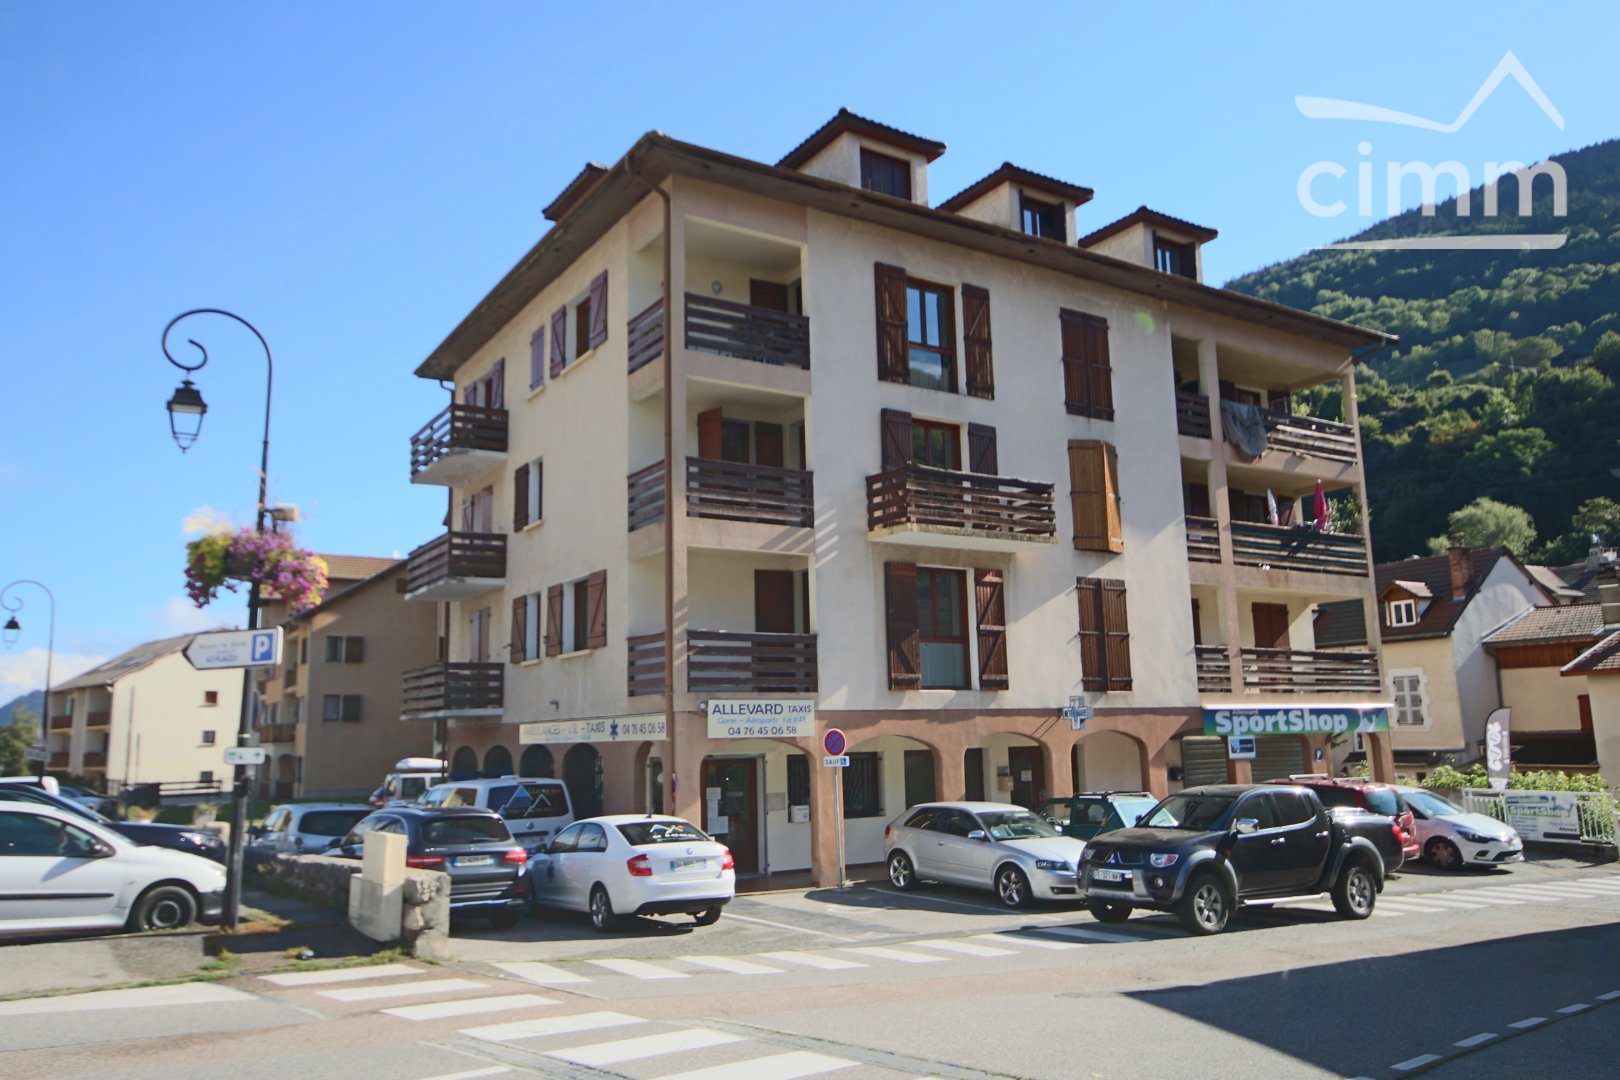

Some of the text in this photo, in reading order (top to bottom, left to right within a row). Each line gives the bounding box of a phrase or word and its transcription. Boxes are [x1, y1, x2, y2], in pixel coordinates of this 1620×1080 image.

[254, 636, 270, 660] P
[712, 703, 811, 715] ALLEVARD TAXIS
[586, 721, 606, 734] TAXIS
[622, 723, 631, 735] 04
[631, 723, 638, 735] 76
[639, 722, 647, 735] 45
[648, 722, 657, 734] 06
[658, 721, 665, 733] 58
[1215, 709, 1348, 736] SportShop
[728, 726, 797, 736] 04 76 45 06 58
[825, 758, 839, 766] SAUF
